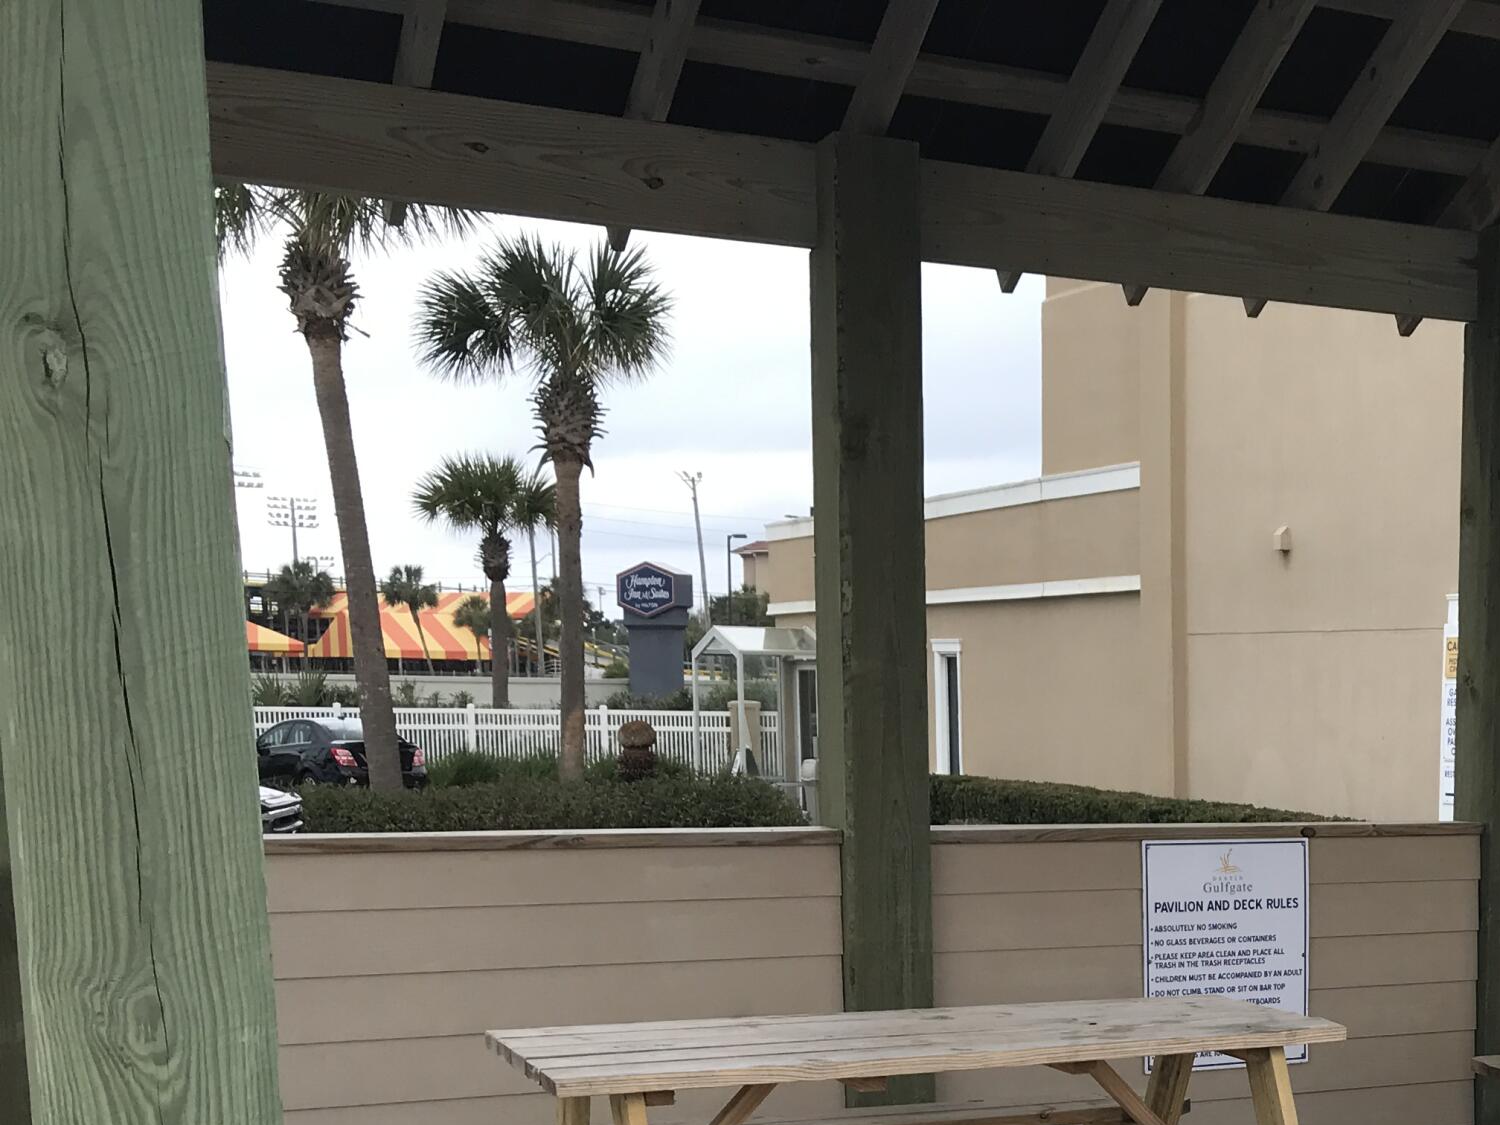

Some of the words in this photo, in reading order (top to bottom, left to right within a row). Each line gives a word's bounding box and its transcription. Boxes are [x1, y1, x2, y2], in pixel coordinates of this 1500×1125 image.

[626, 574, 665, 588] Hampton
[1203, 882, 1253, 895] Gulfgate
[1154, 901, 1203, 913] PAVILION
[1207, 900, 1230, 912] AND
[1234, 899, 1263, 910] DECK
[1266, 898, 1298, 909] RULES
[1188, 937, 1225, 945] BEVERAGES
[1238, 935, 1276, 943] CONTAINERS
[1224, 958, 1265, 966] RECEPTACLES
[1218, 971, 1262, 980] ACCOMPANIED
